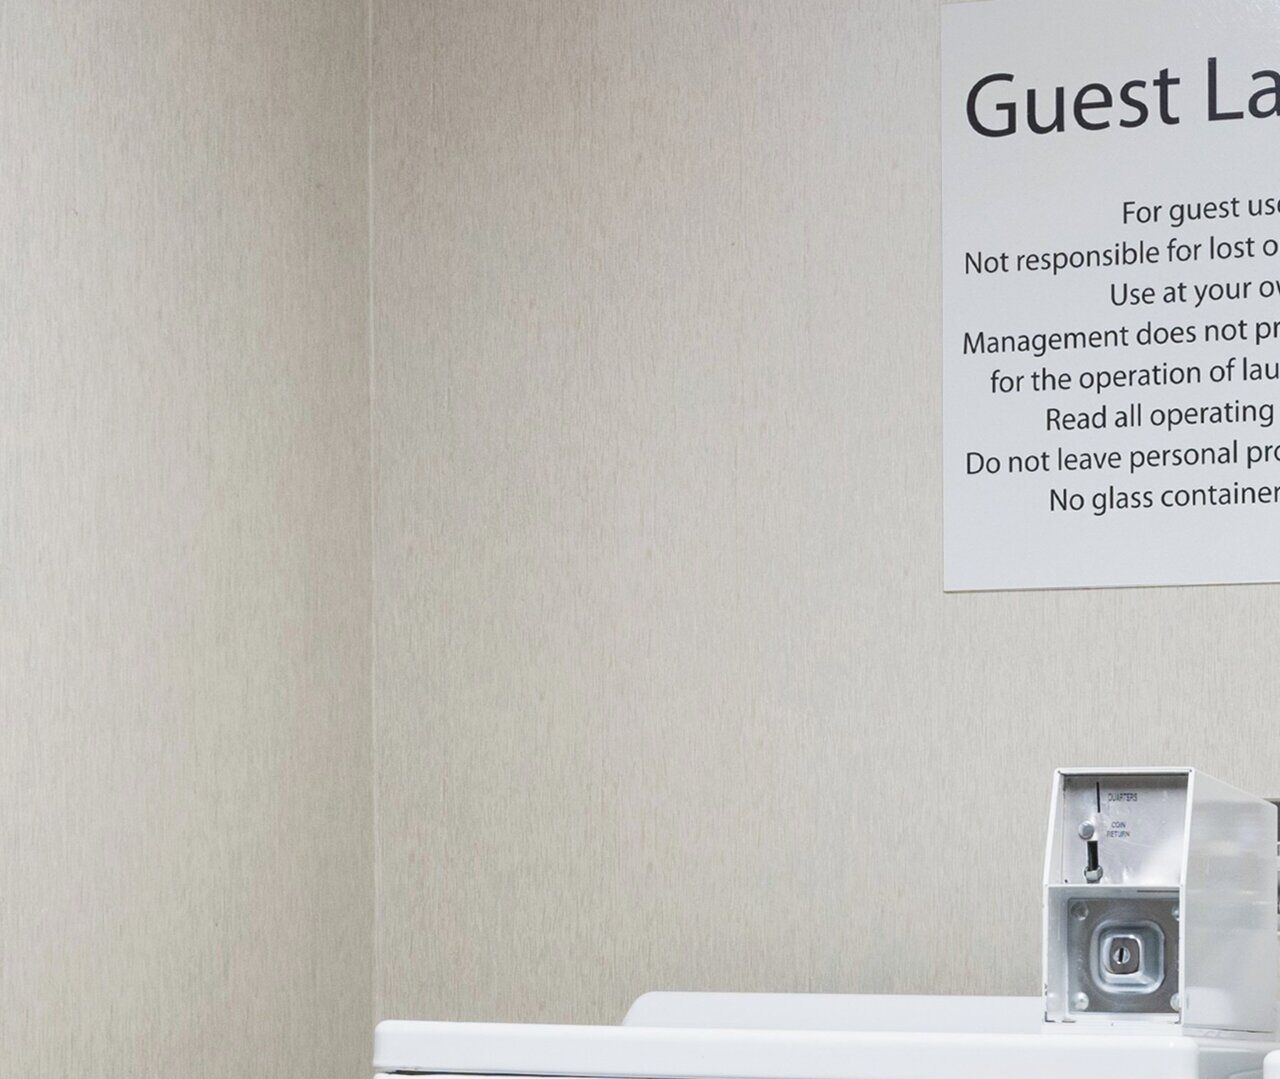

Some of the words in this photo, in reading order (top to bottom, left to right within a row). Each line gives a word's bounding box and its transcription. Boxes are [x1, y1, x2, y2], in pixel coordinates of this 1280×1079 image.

[966, 68, 1180, 137] Guest
[1123, 201, 1162, 224] For
[1169, 198, 1240, 227] guest
[966, 252, 1009, 274] Not
[1017, 240, 1159, 275] responsible
[1167, 238, 1202, 262] for
[1210, 236, 1255, 259] lost
[1111, 283, 1155, 306] Use
[1163, 283, 1187, 303] at
[1194, 282, 1252, 308] your
[963, 327, 1129, 357] Management
[1136, 321, 1196, 345] does
[1205, 320, 1247, 341] not
[990, 369, 1024, 393] for
[1031, 367, 1071, 391] the
[1079, 362, 1200, 394] operation
[1210, 357, 1236, 382] of
[1047, 405, 1106, 431] Read
[1115, 403, 1141, 428] all
[1150, 400, 1273, 431] operating
[967, 452, 1000, 474] Do
[1009, 452, 1050, 472] not
[1058, 447, 1121, 470] leave
[1131, 440, 1237, 474] personal
[1051, 489, 1084, 511] No
[1092, 485, 1153, 516] glass
[1108, 793, 1138, 801] QUARTERS
